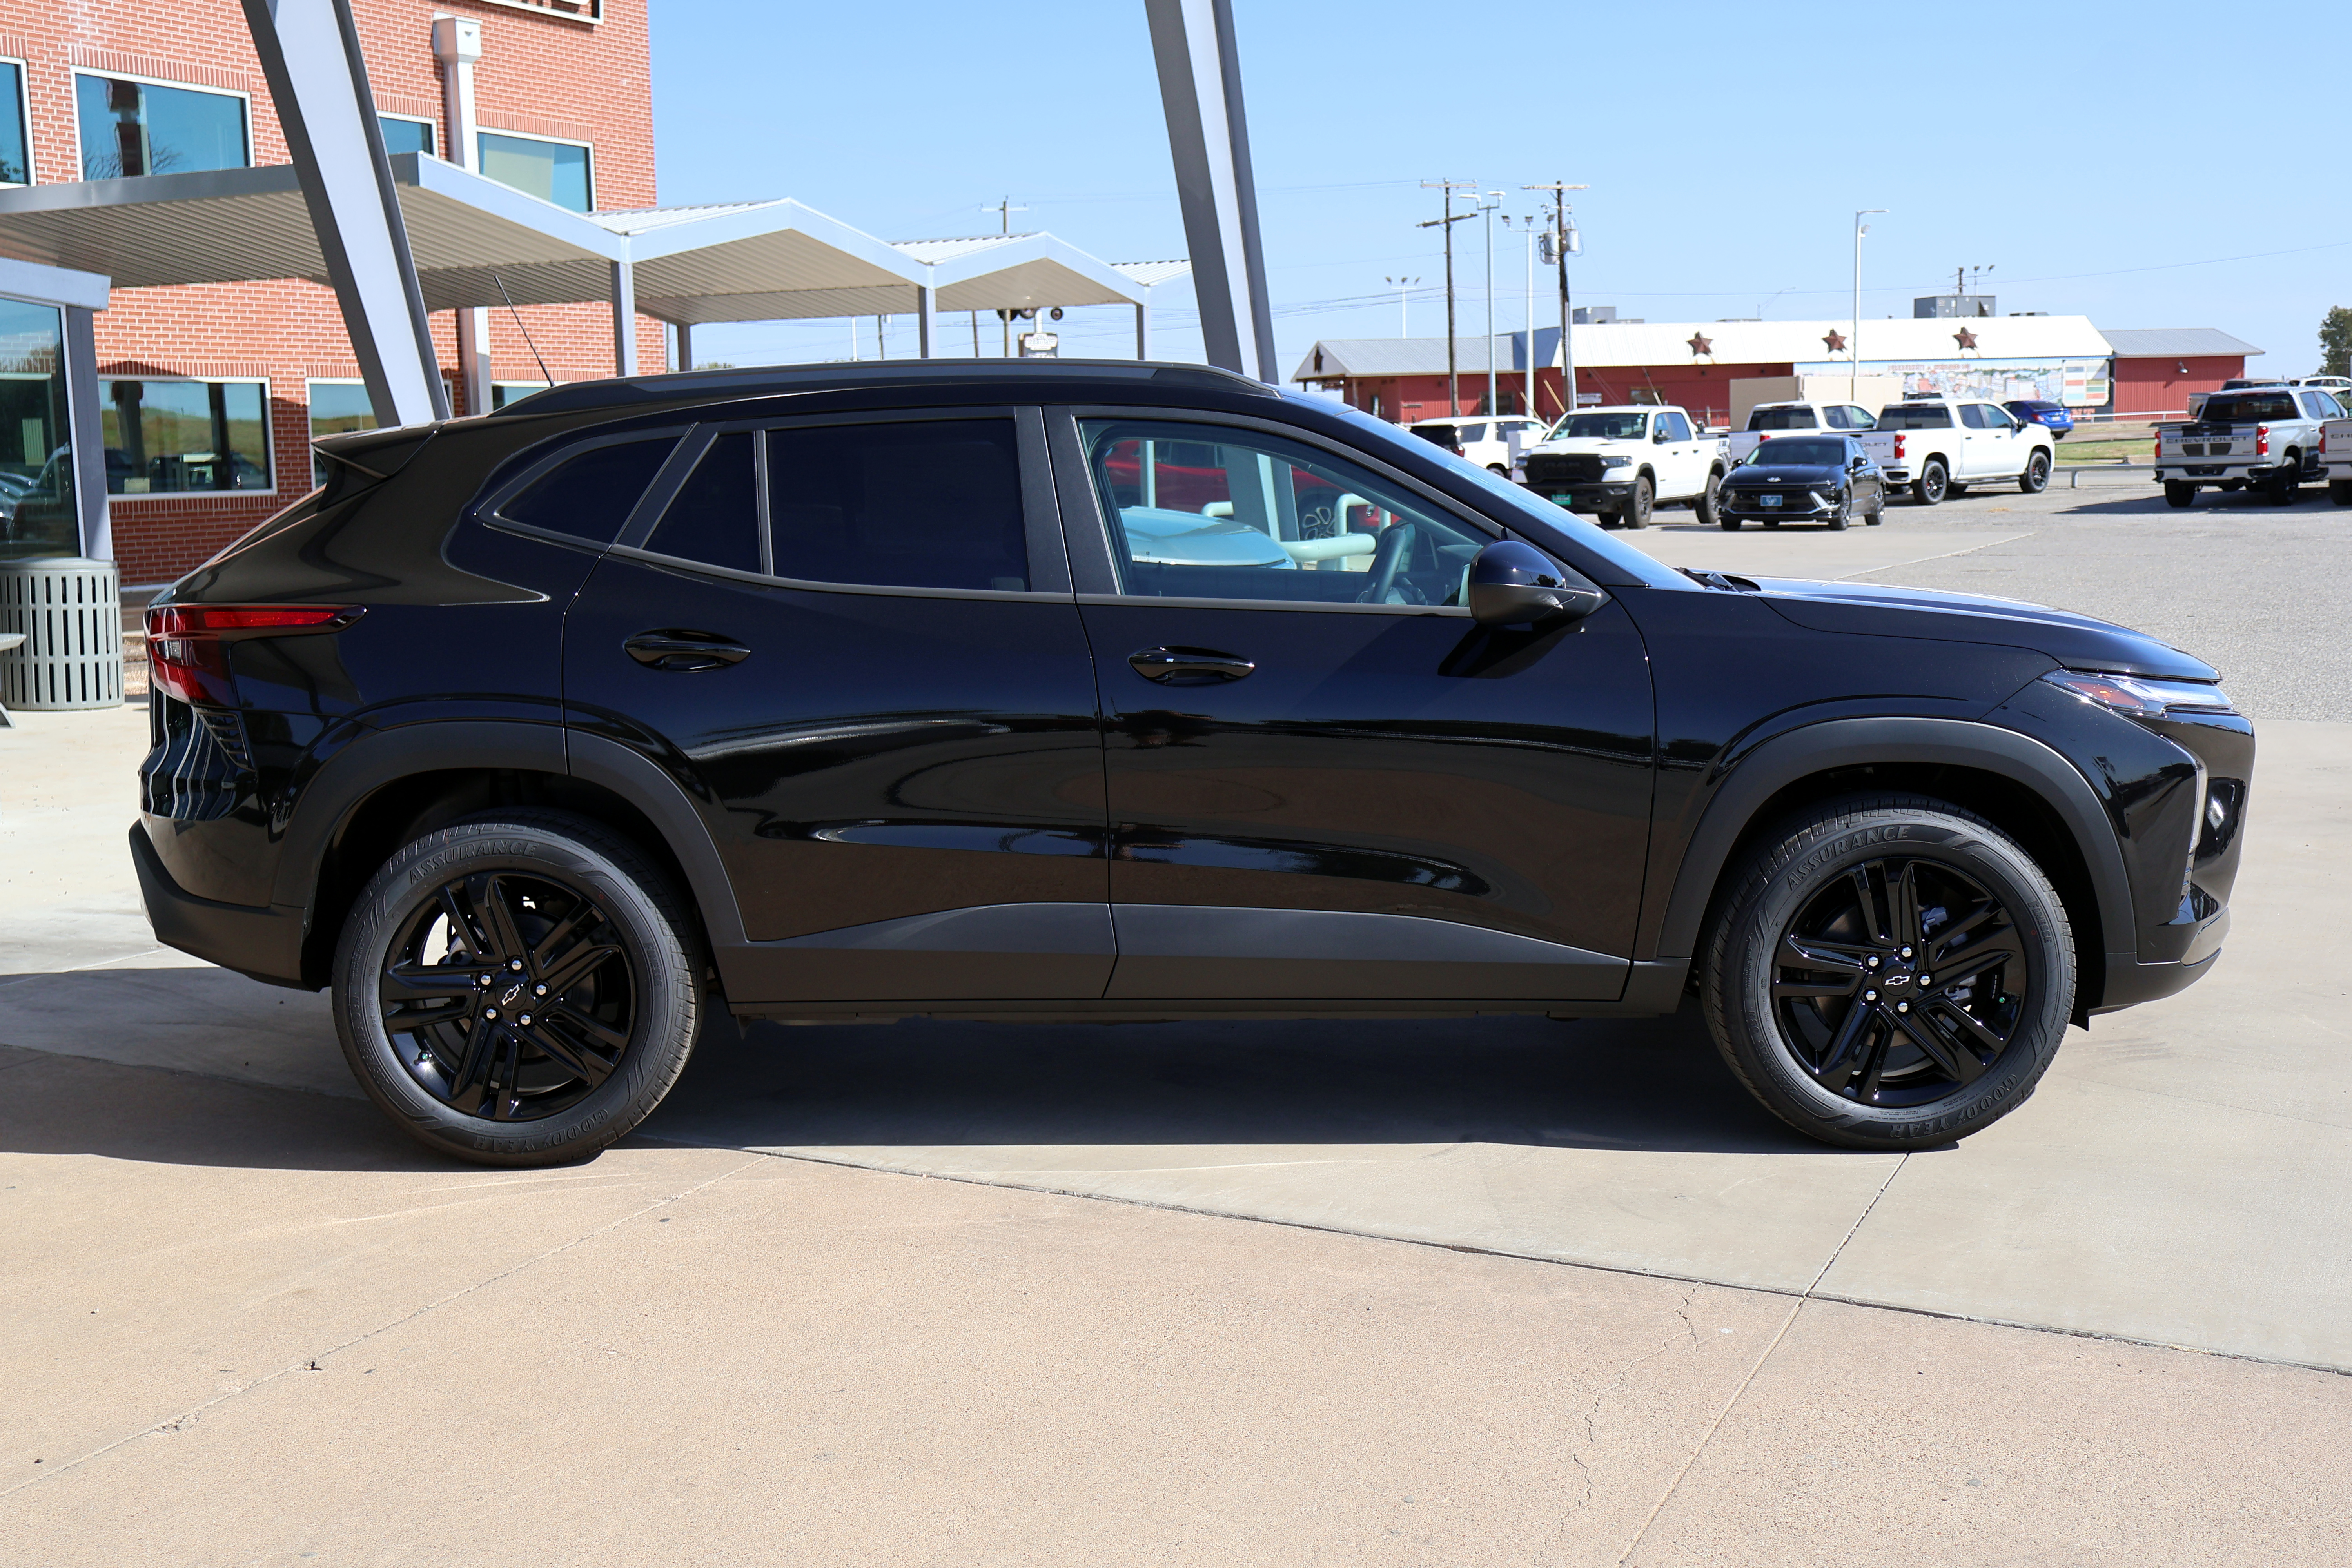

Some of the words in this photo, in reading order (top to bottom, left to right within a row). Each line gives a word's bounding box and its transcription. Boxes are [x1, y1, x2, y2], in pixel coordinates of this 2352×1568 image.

[2165, 435, 2250, 444] CHEVROLET
[410, 839, 539, 885] ASSURANCE
[1788, 826, 1910, 891] ASSURANCE
[2028, 900, 2052, 944] FINESSE
[643, 942, 662, 987] FINESSE
